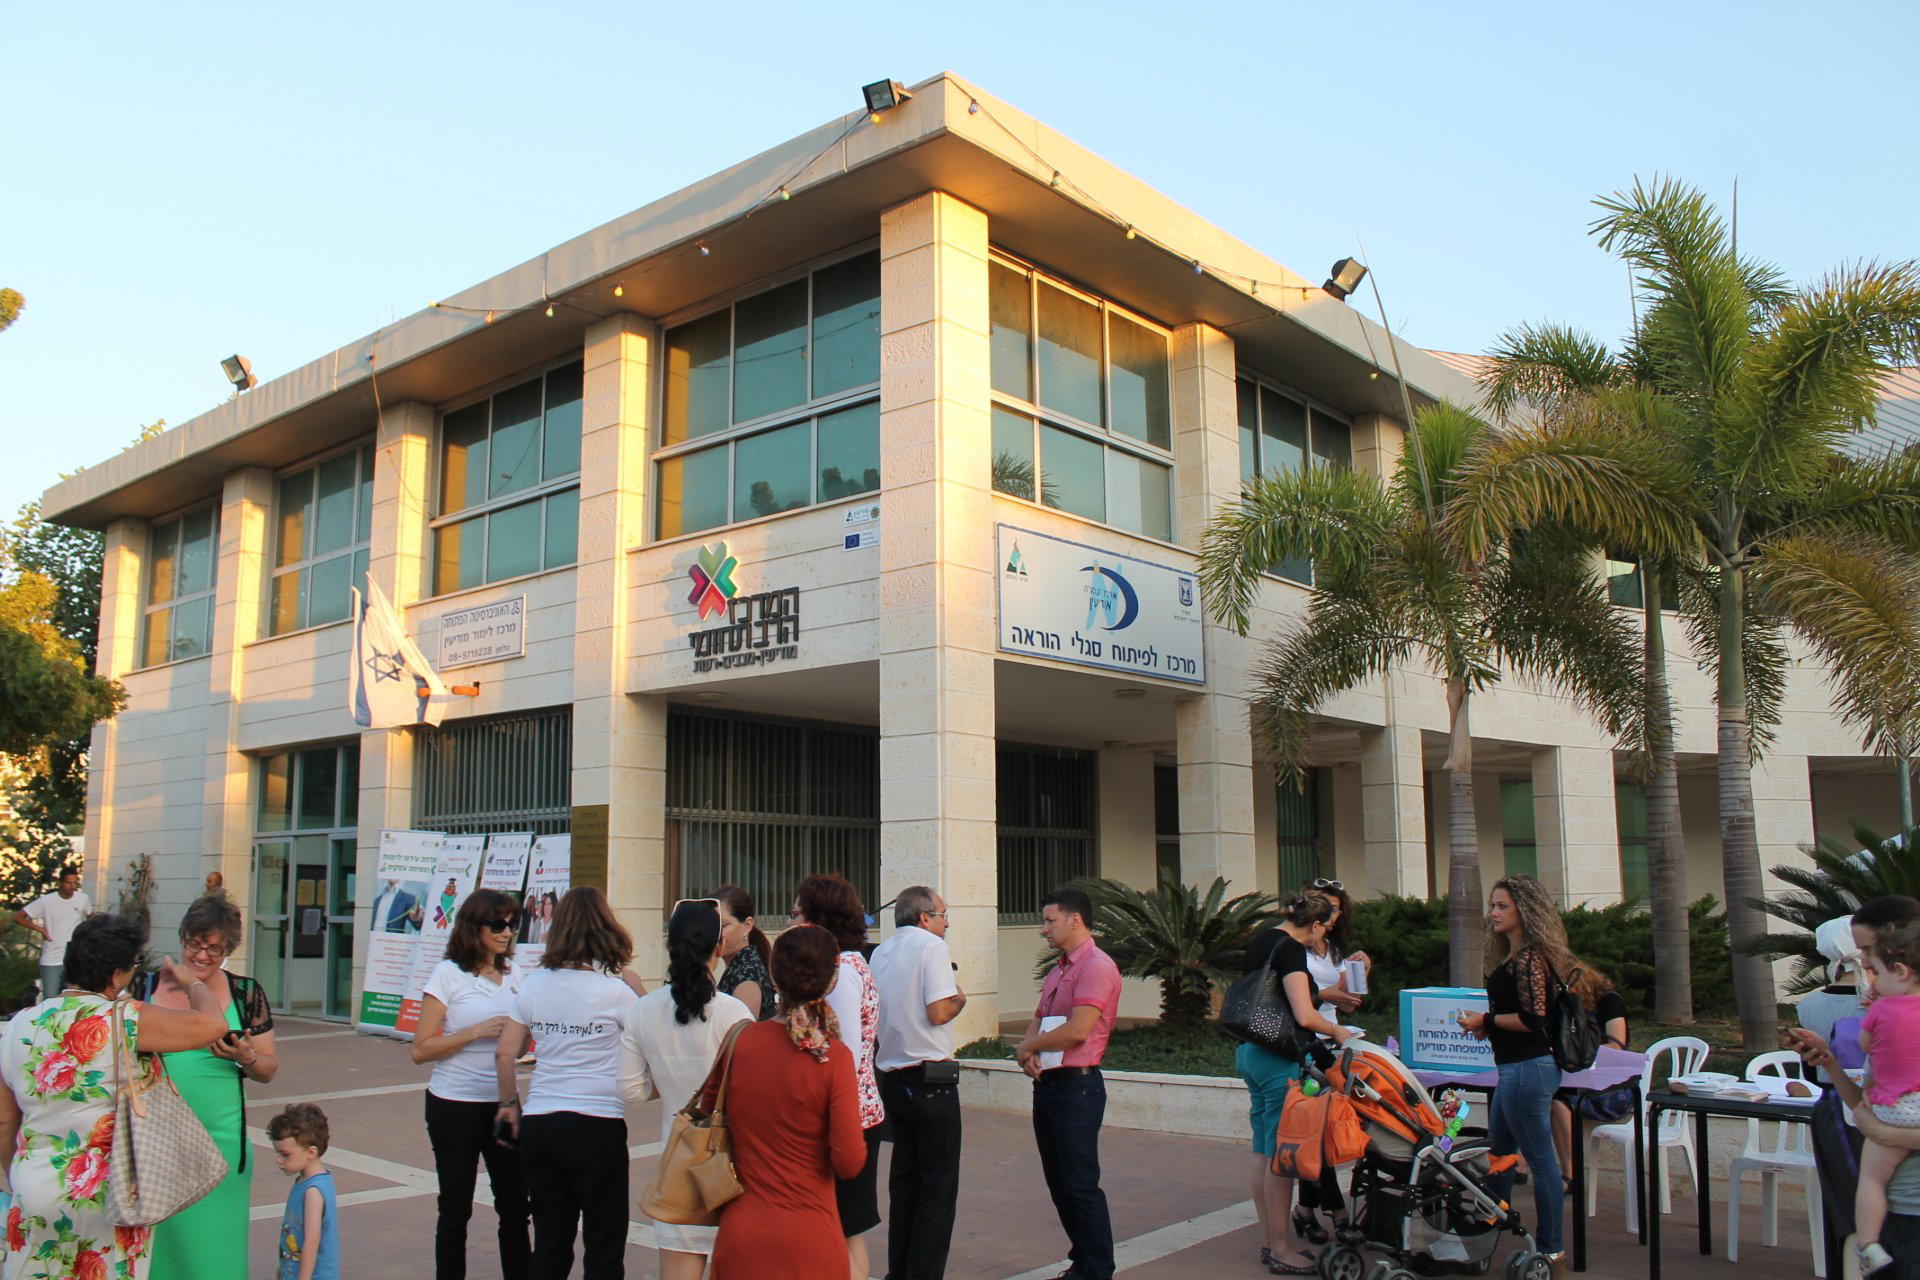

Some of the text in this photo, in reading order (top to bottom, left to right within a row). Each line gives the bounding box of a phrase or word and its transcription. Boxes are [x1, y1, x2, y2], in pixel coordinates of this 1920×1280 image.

[727, 586, 799, 625] המרכז
[443, 604, 509, 629] האוניברסיטה הפתוחה
[443, 623, 516, 648] מרכז לימוד מודיעין
[448, 644, 510, 662] טלפון 08-9719238
[1011, 626, 1196, 675] מרכז לפיתוח סגלי הוראה
[545, 1022, 560, 1035] דרך
[1418, 1029, 1448, 1040] להורות
[1416, 1041, 1446, 1052] מודיעין
